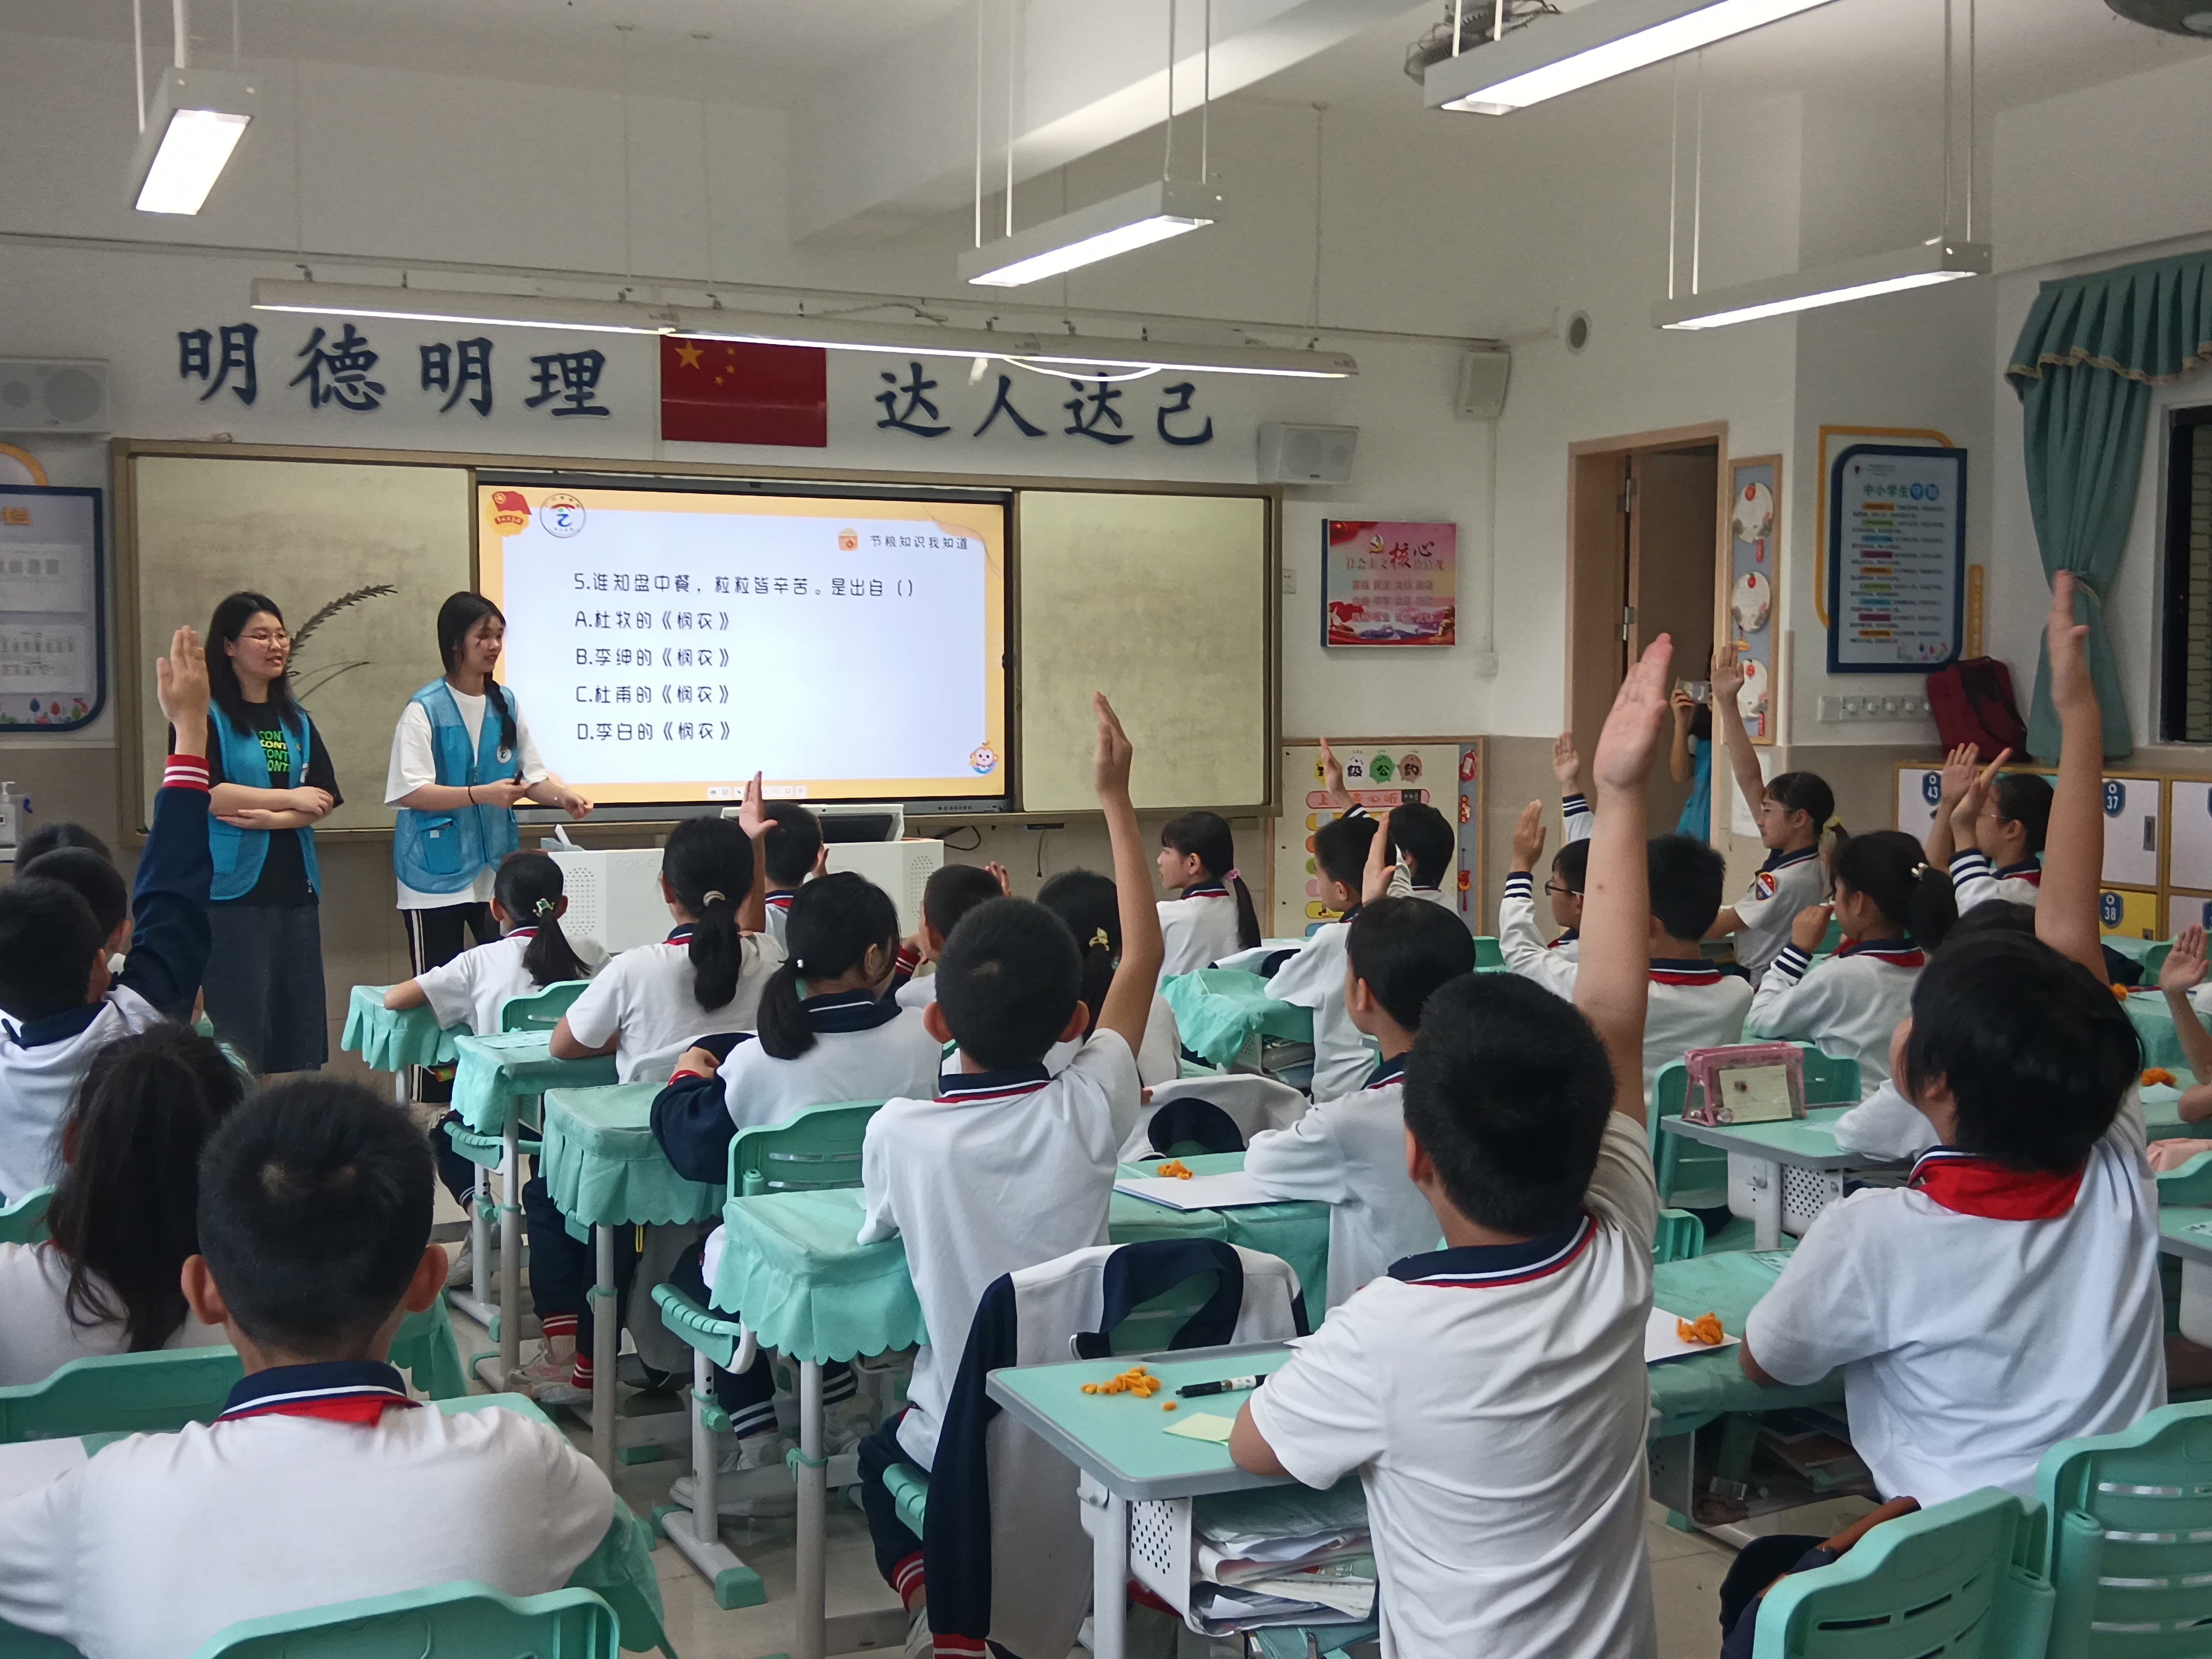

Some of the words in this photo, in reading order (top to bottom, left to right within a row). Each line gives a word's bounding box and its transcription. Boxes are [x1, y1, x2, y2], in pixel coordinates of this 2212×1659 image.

[178, 323, 610, 417] 明德明理
[875, 362, 1213, 446] 达人达己
[575, 610, 729, 631] A.杜牧的《悯农》
[576, 647, 729, 667] B.李绅的《悯农》
[576, 684, 729, 704] C.杜甫的《悯农》
[258, 731, 283, 741] CON
[577, 720, 730, 741] D.李白的《悯农》
[264, 748, 289, 763] ONT
[2107, 795, 2118, 809] 37
[2104, 906, 2116, 921] 38
